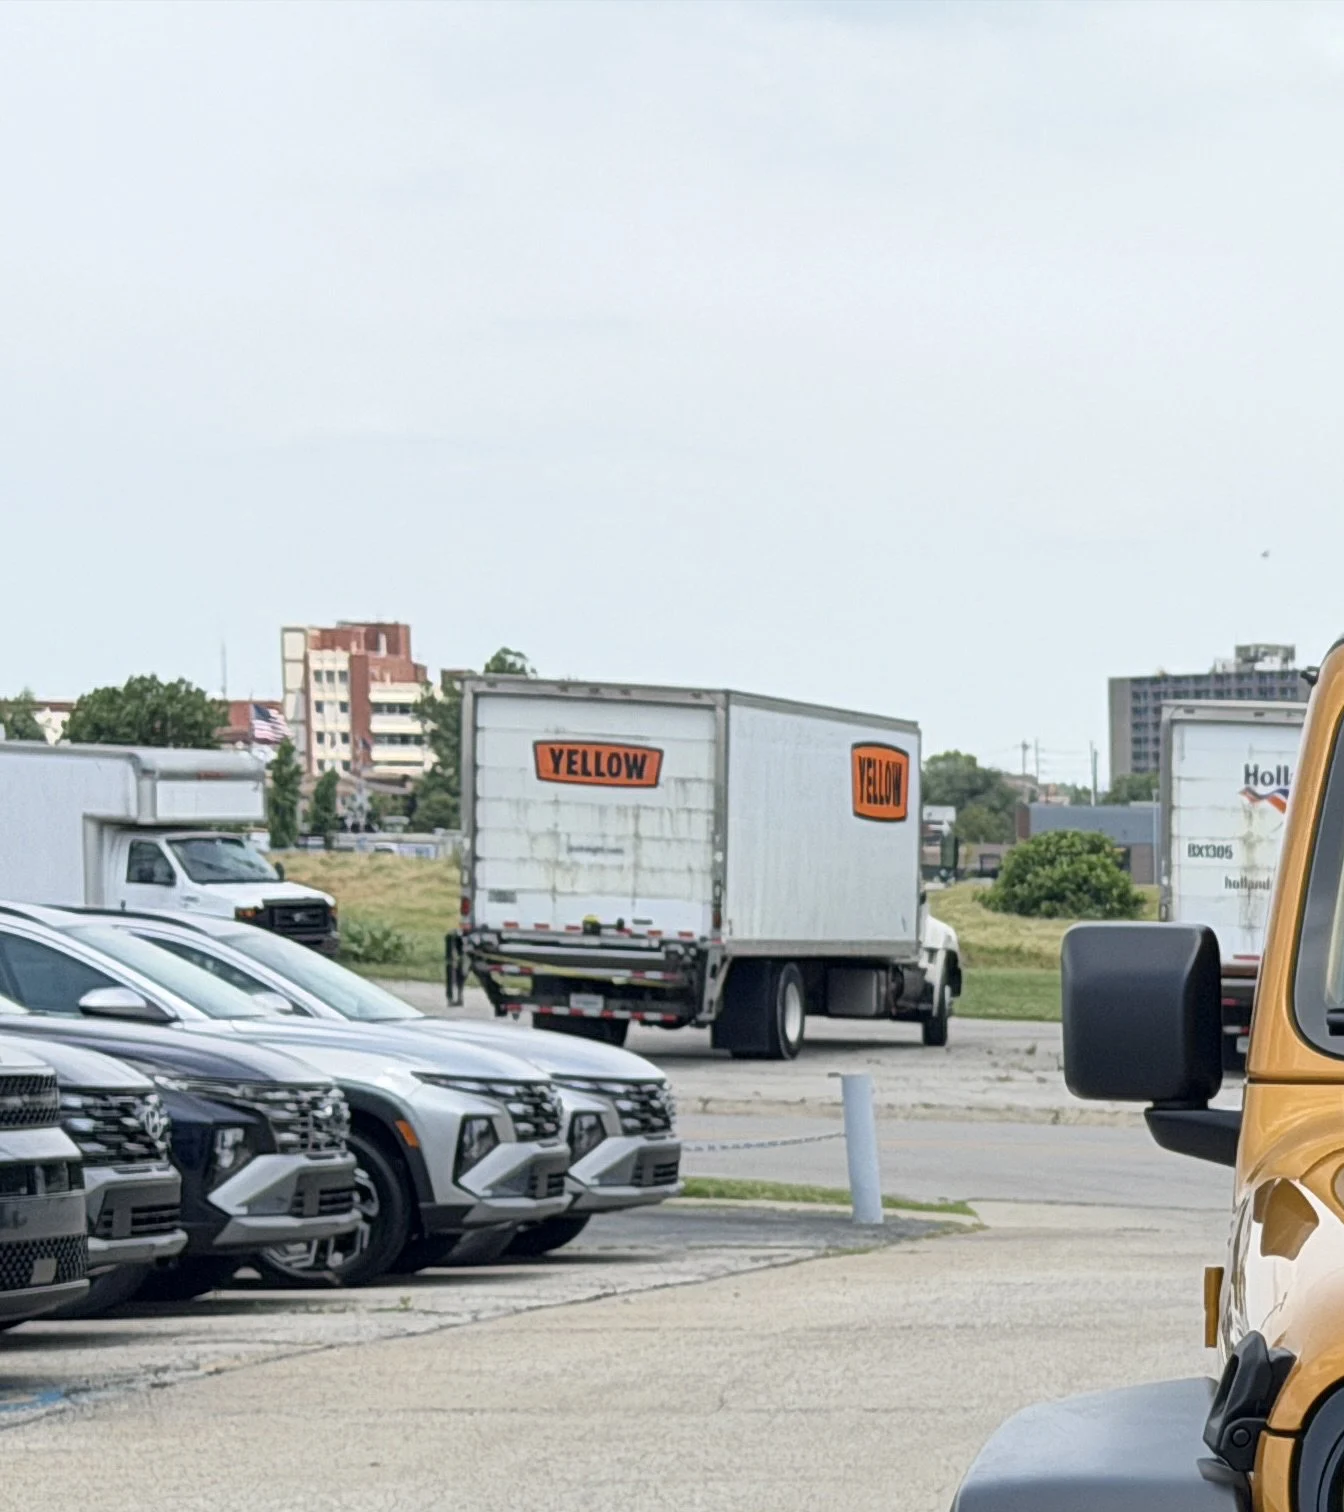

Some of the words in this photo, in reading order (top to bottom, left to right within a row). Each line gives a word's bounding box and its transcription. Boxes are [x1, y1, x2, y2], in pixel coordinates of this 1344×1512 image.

[549, 748, 647, 780] YELLOW
[1243, 763, 1292, 787] Holl
[858, 755, 902, 808] YELLOW
